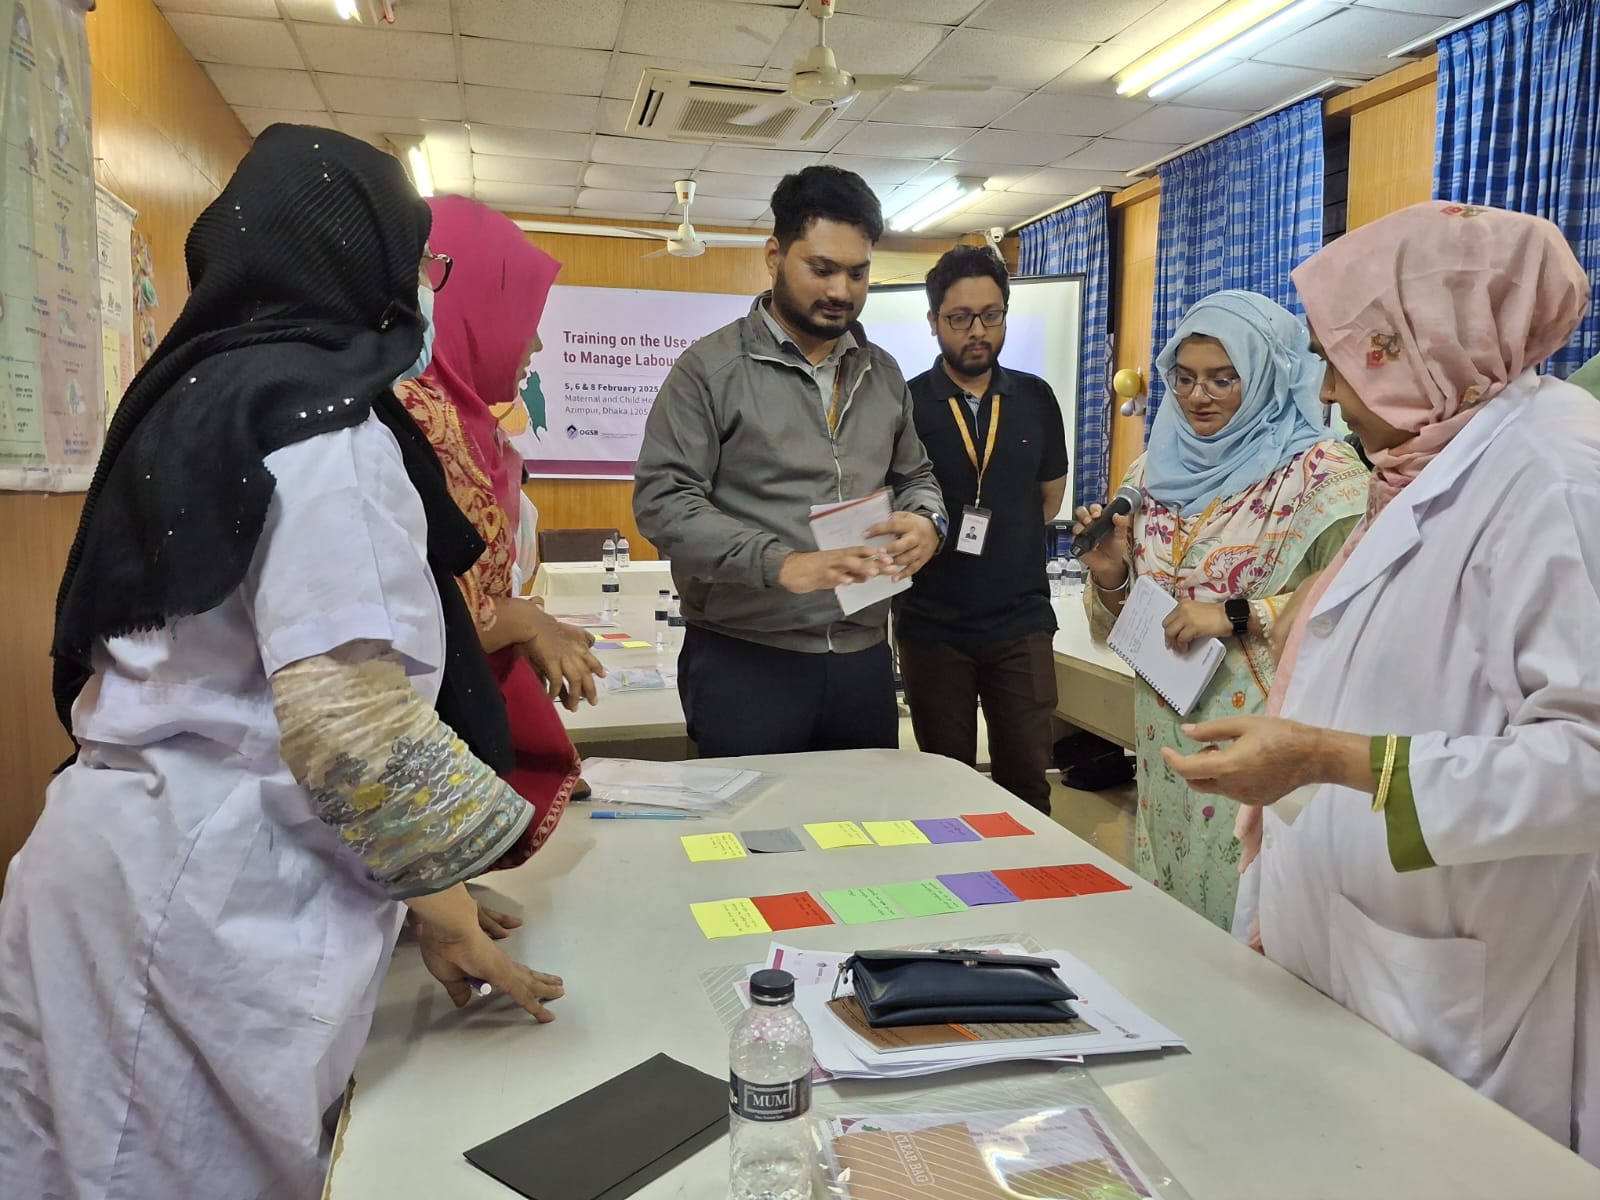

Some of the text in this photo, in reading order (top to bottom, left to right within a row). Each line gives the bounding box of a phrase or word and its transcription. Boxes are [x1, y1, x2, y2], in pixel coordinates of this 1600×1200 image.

[563, 331, 616, 348] Training
[620, 336, 636, 346] on
[640, 334, 660, 347] the
[664, 335, 687, 348] Use
[563, 351, 576, 363] to
[580, 351, 631, 368] Manage
[564, 383, 573, 391] 5,
[598, 383, 637, 393] February
[639, 385, 659, 393] 2025
[564, 394, 600, 403] Maternal
[602, 395, 617, 404] and
[619, 395, 639, 404] Child
[565, 406, 648, 416] Azimpur, Dhaka 1205
[752, 1093, 787, 1107] MUM
[894, 1134, 928, 1182] CLEAR BAG
